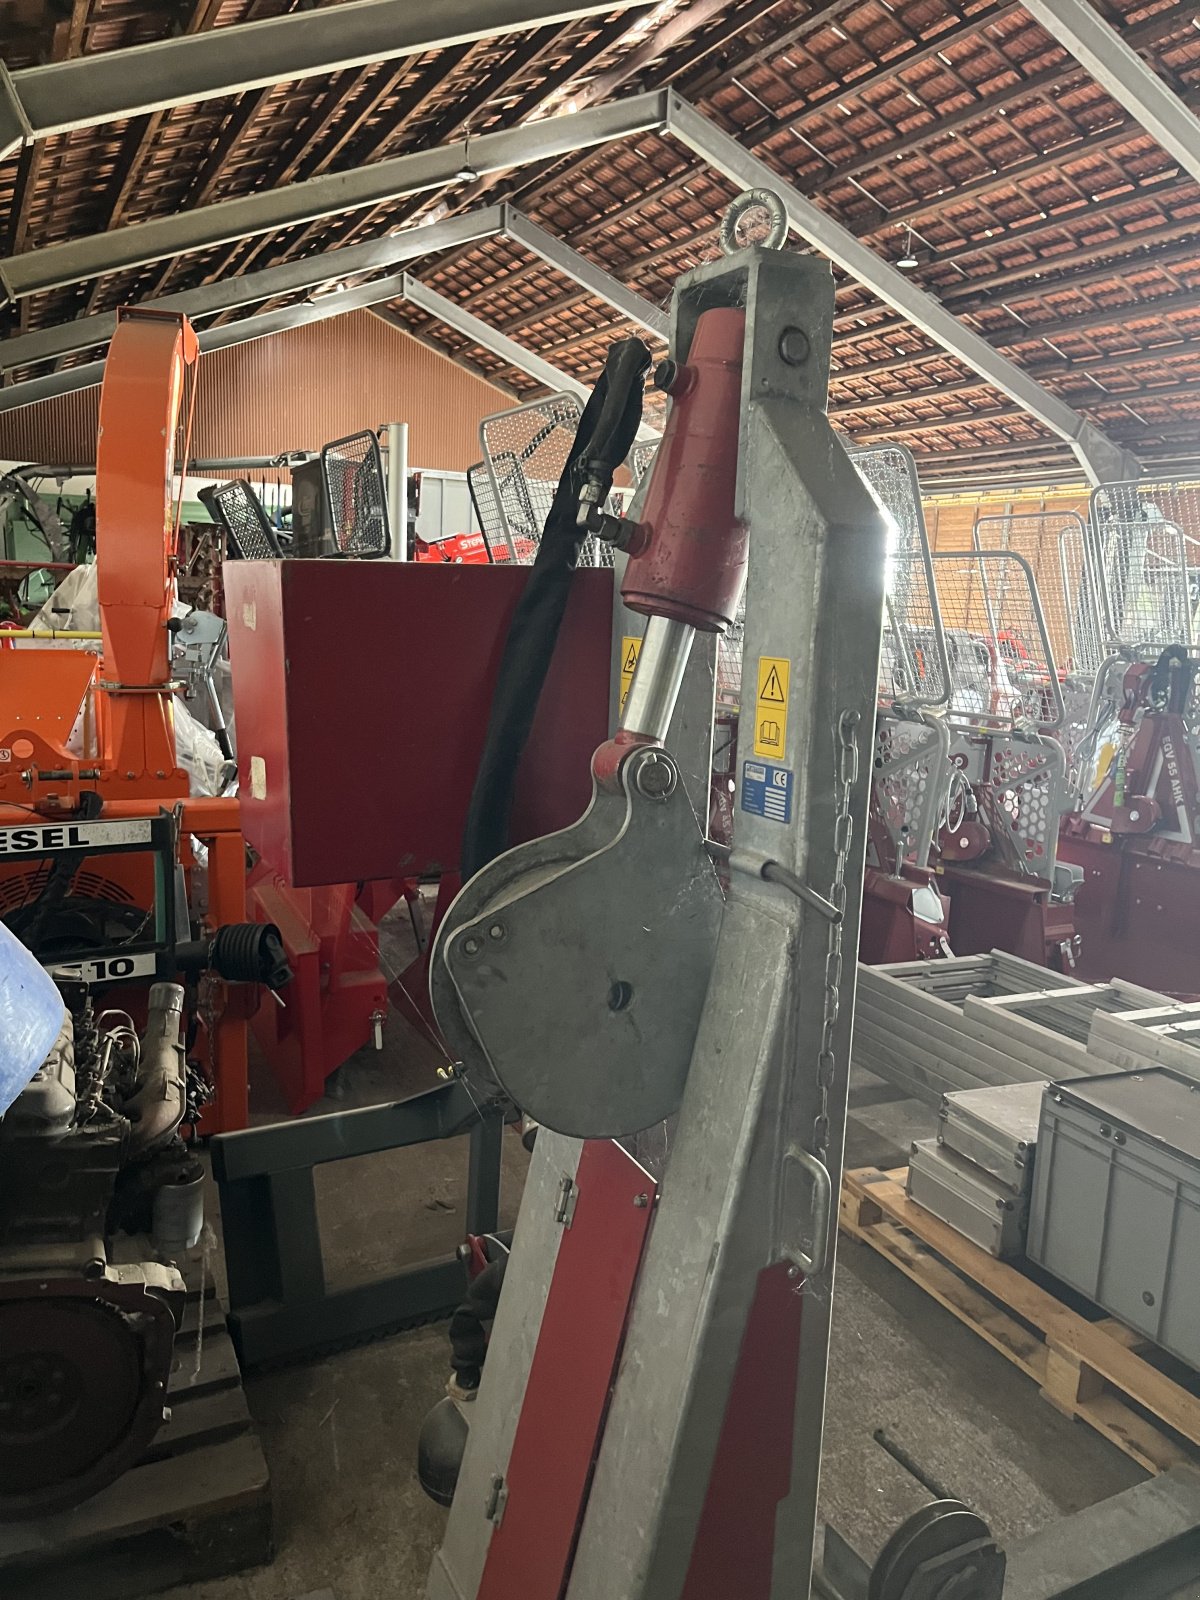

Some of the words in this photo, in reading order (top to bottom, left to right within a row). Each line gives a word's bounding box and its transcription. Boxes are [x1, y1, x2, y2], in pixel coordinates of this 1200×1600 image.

[1162, 736, 1175, 758] EGV
[1167, 762, 1178, 776] 55
[1171, 779, 1184, 804] AHK
